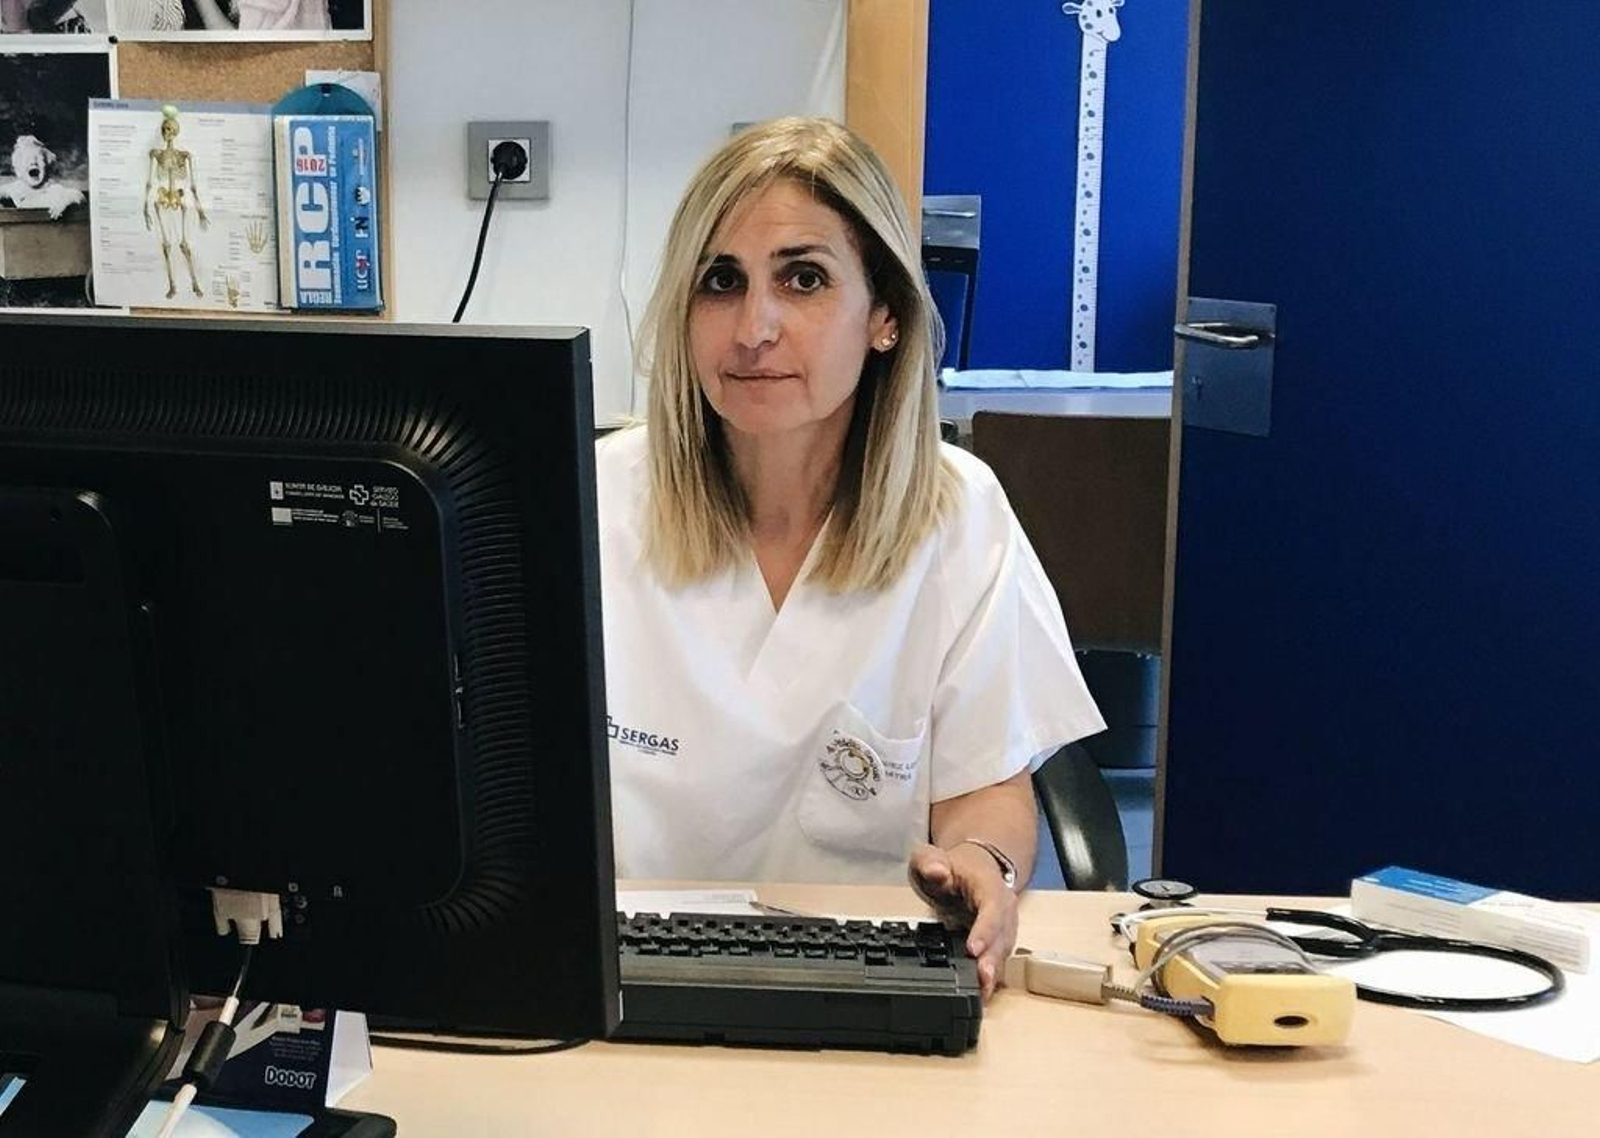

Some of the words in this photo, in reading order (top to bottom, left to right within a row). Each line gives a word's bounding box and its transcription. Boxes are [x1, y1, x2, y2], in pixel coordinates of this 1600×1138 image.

[296, 157, 325, 172] 2016
[294, 126, 332, 290] RCP
[620, 727, 680, 751] SERGAS
[265, 1066, 316, 1089] DODOT
